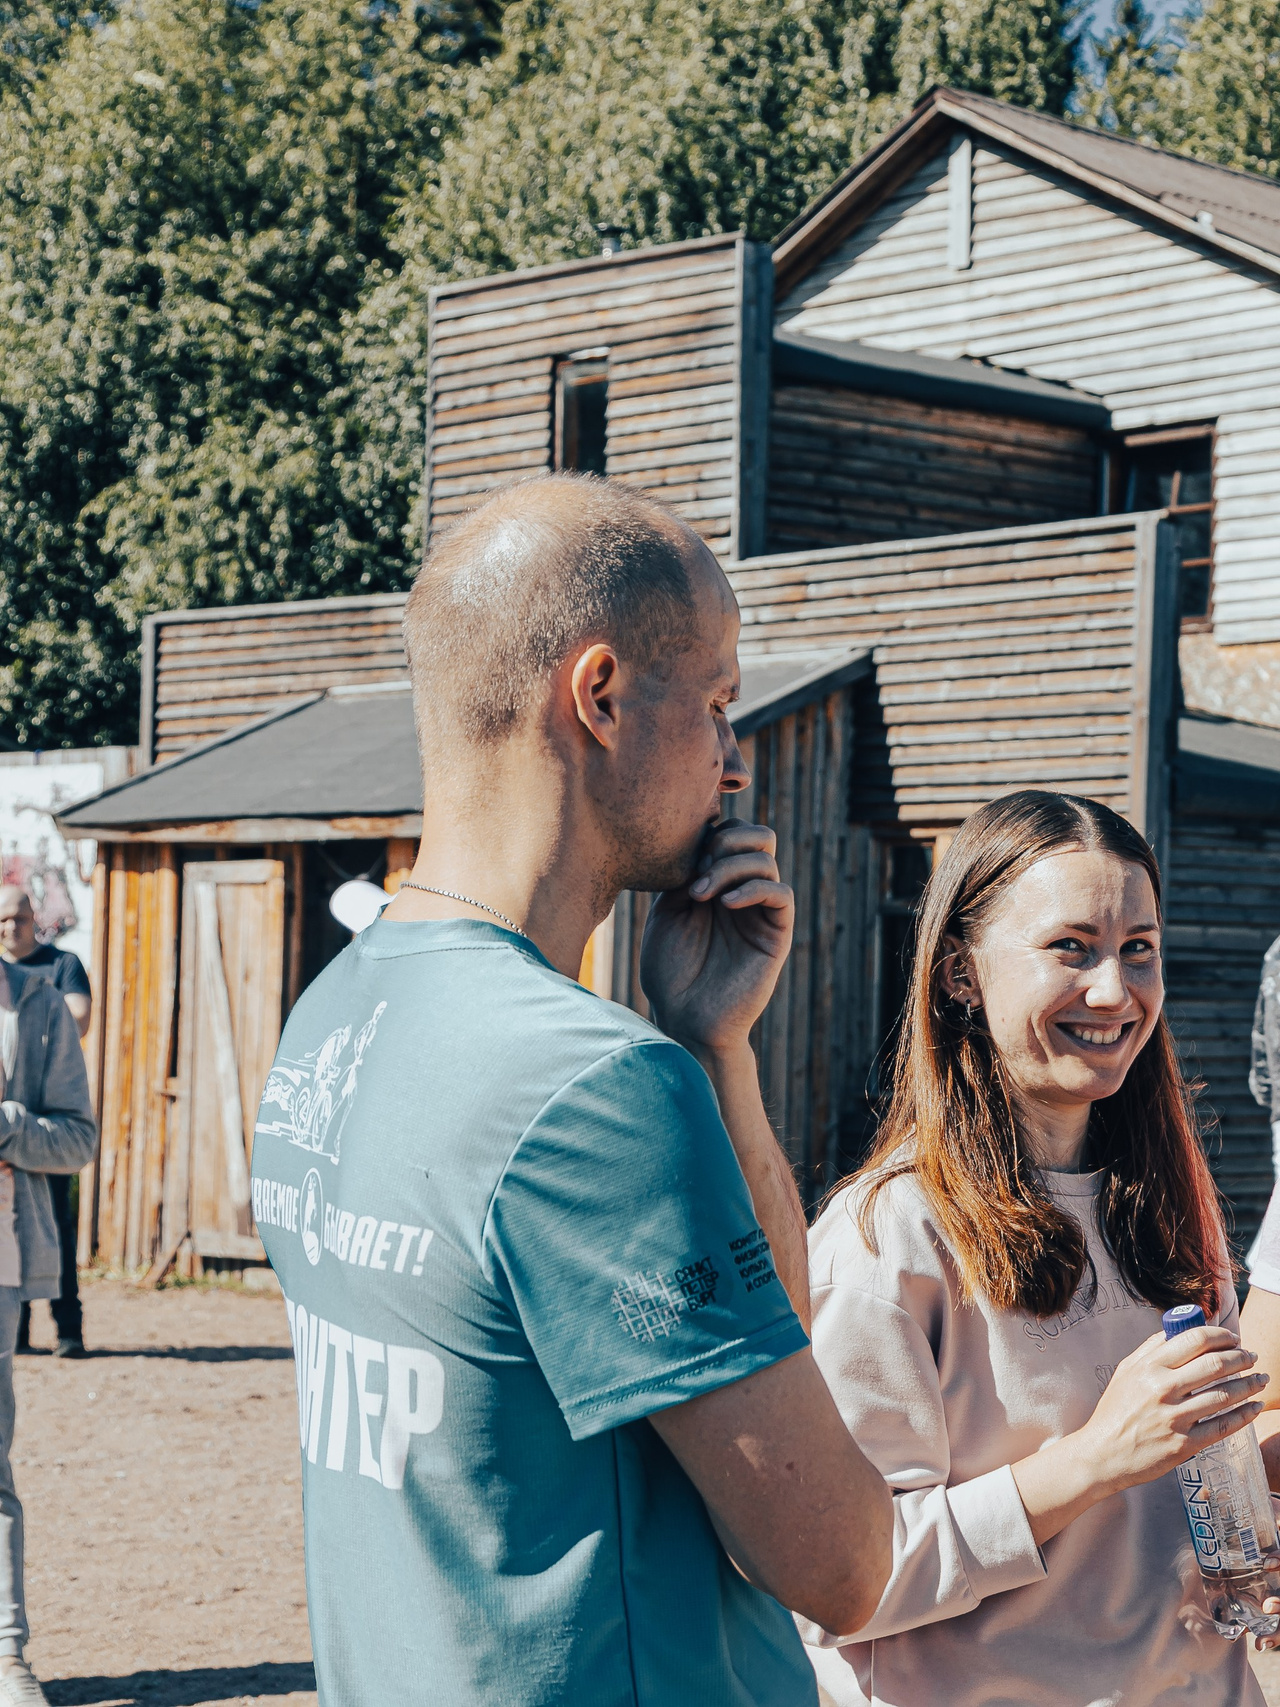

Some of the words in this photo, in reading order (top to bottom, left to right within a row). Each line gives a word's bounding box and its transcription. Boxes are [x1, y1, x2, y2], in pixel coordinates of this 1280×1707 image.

[252, 1177, 299, 1233] ВАЕМОЕ
[324, 1203, 434, 1276] БЫВАЕТ!
[1178, 1454, 1222, 1570] LEDENE
